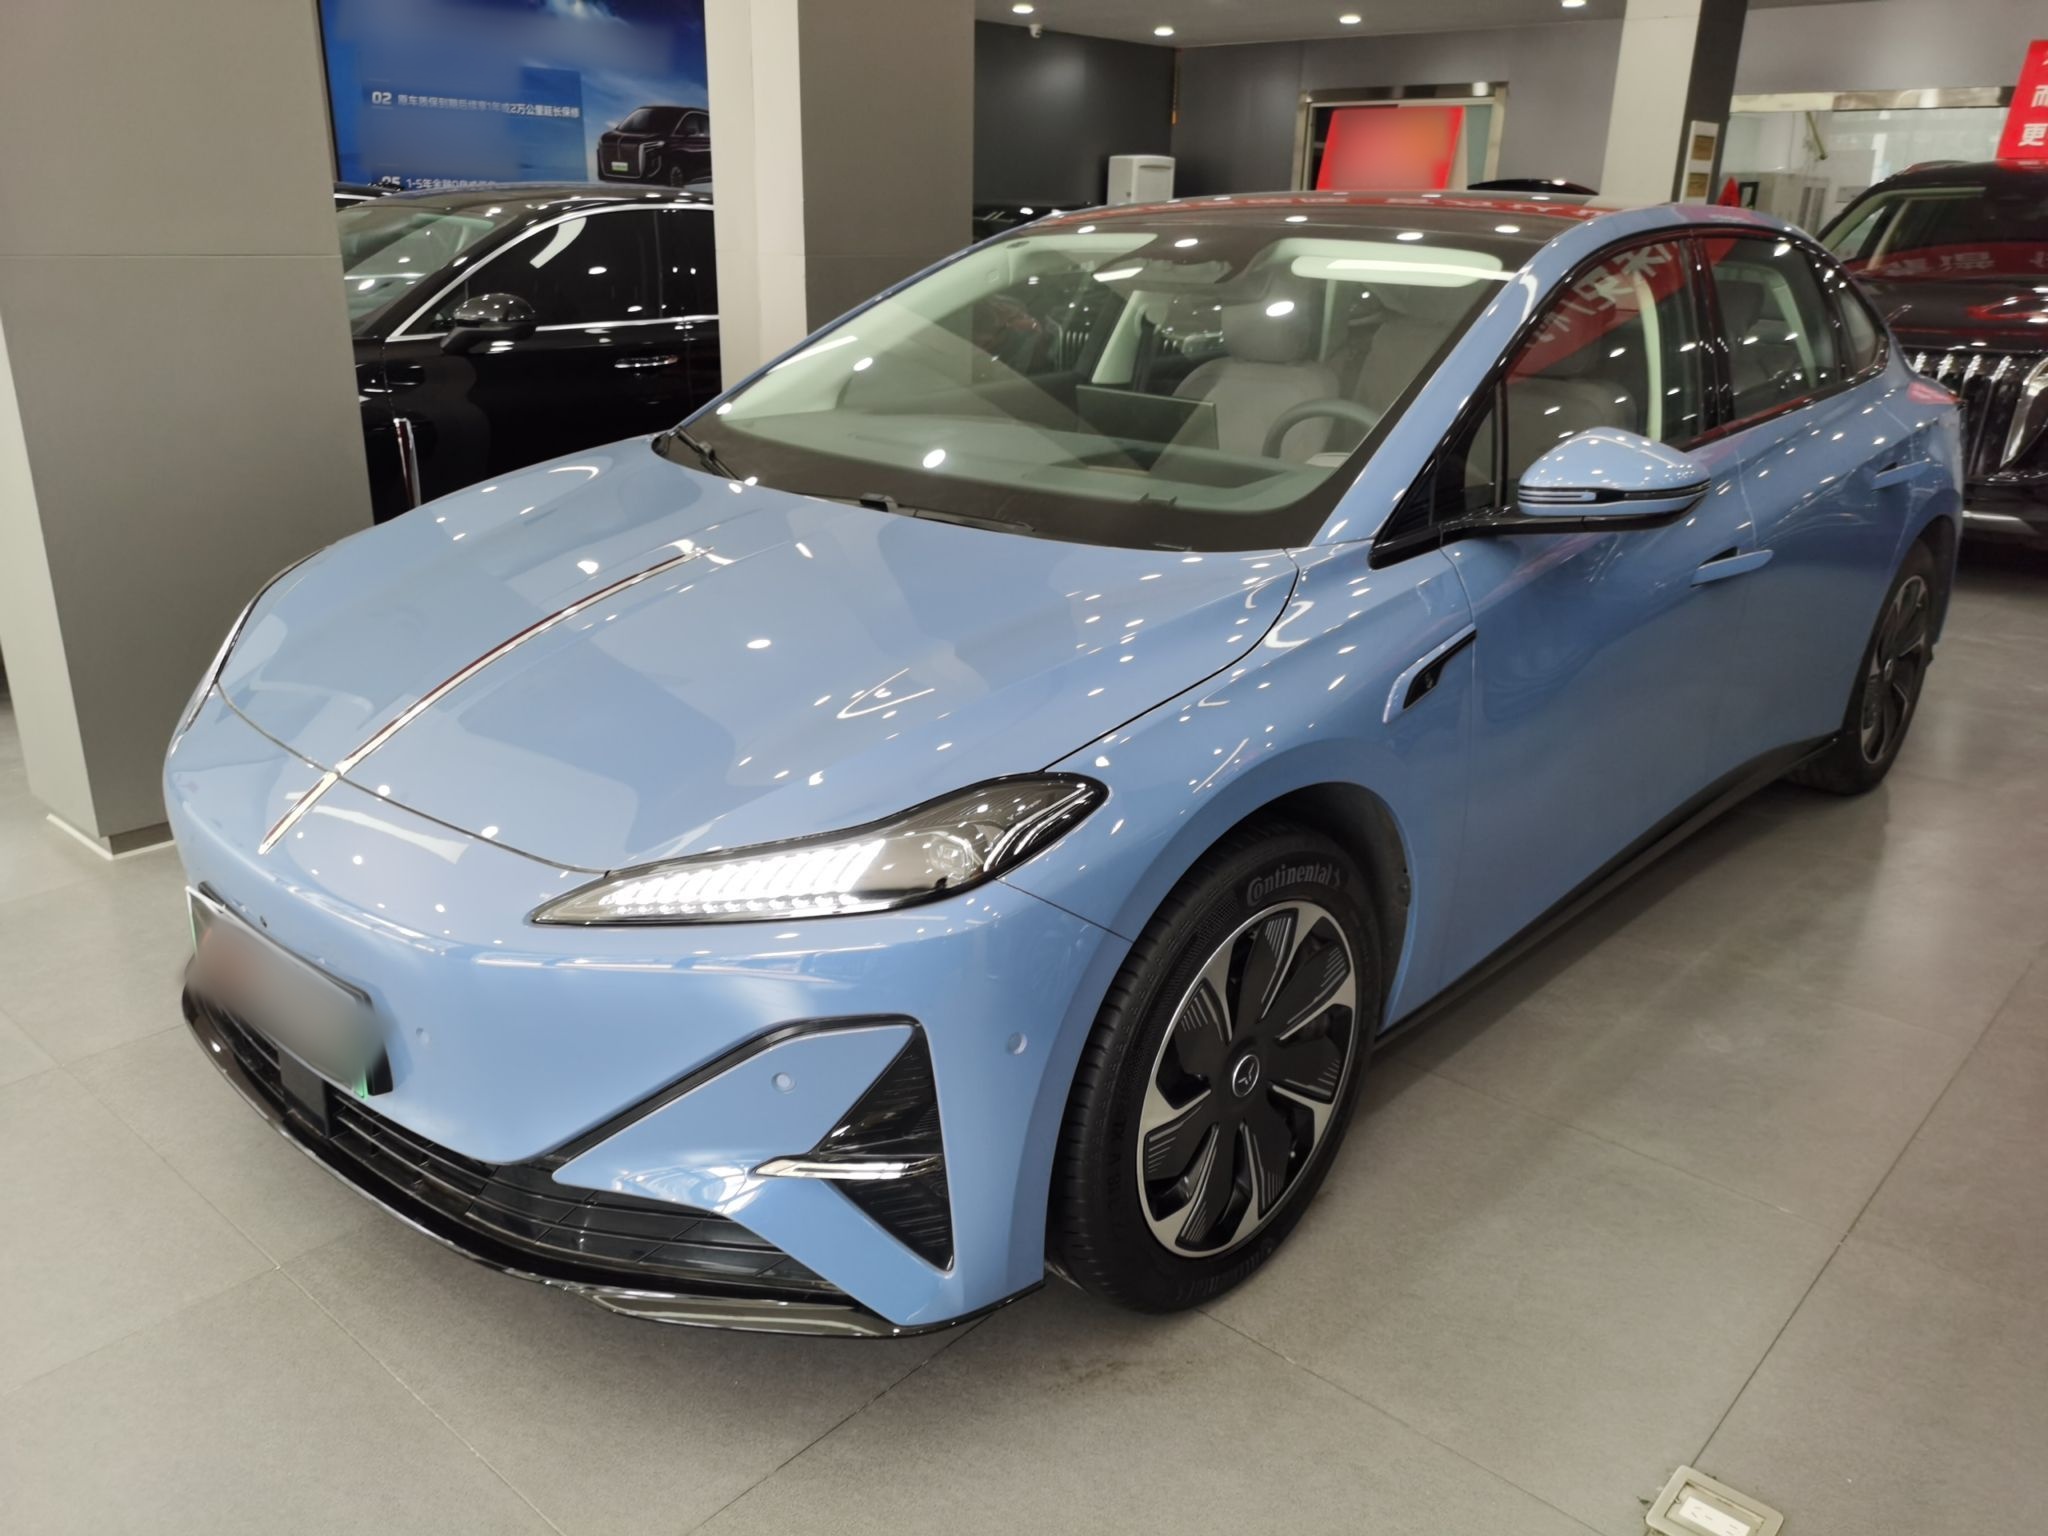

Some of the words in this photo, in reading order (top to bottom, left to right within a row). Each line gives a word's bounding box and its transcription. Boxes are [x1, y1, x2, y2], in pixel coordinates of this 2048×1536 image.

[372, 91, 392, 105] 02
[2018, 123, 2048, 146] 更
[1247, 862, 1333, 906] Continental
